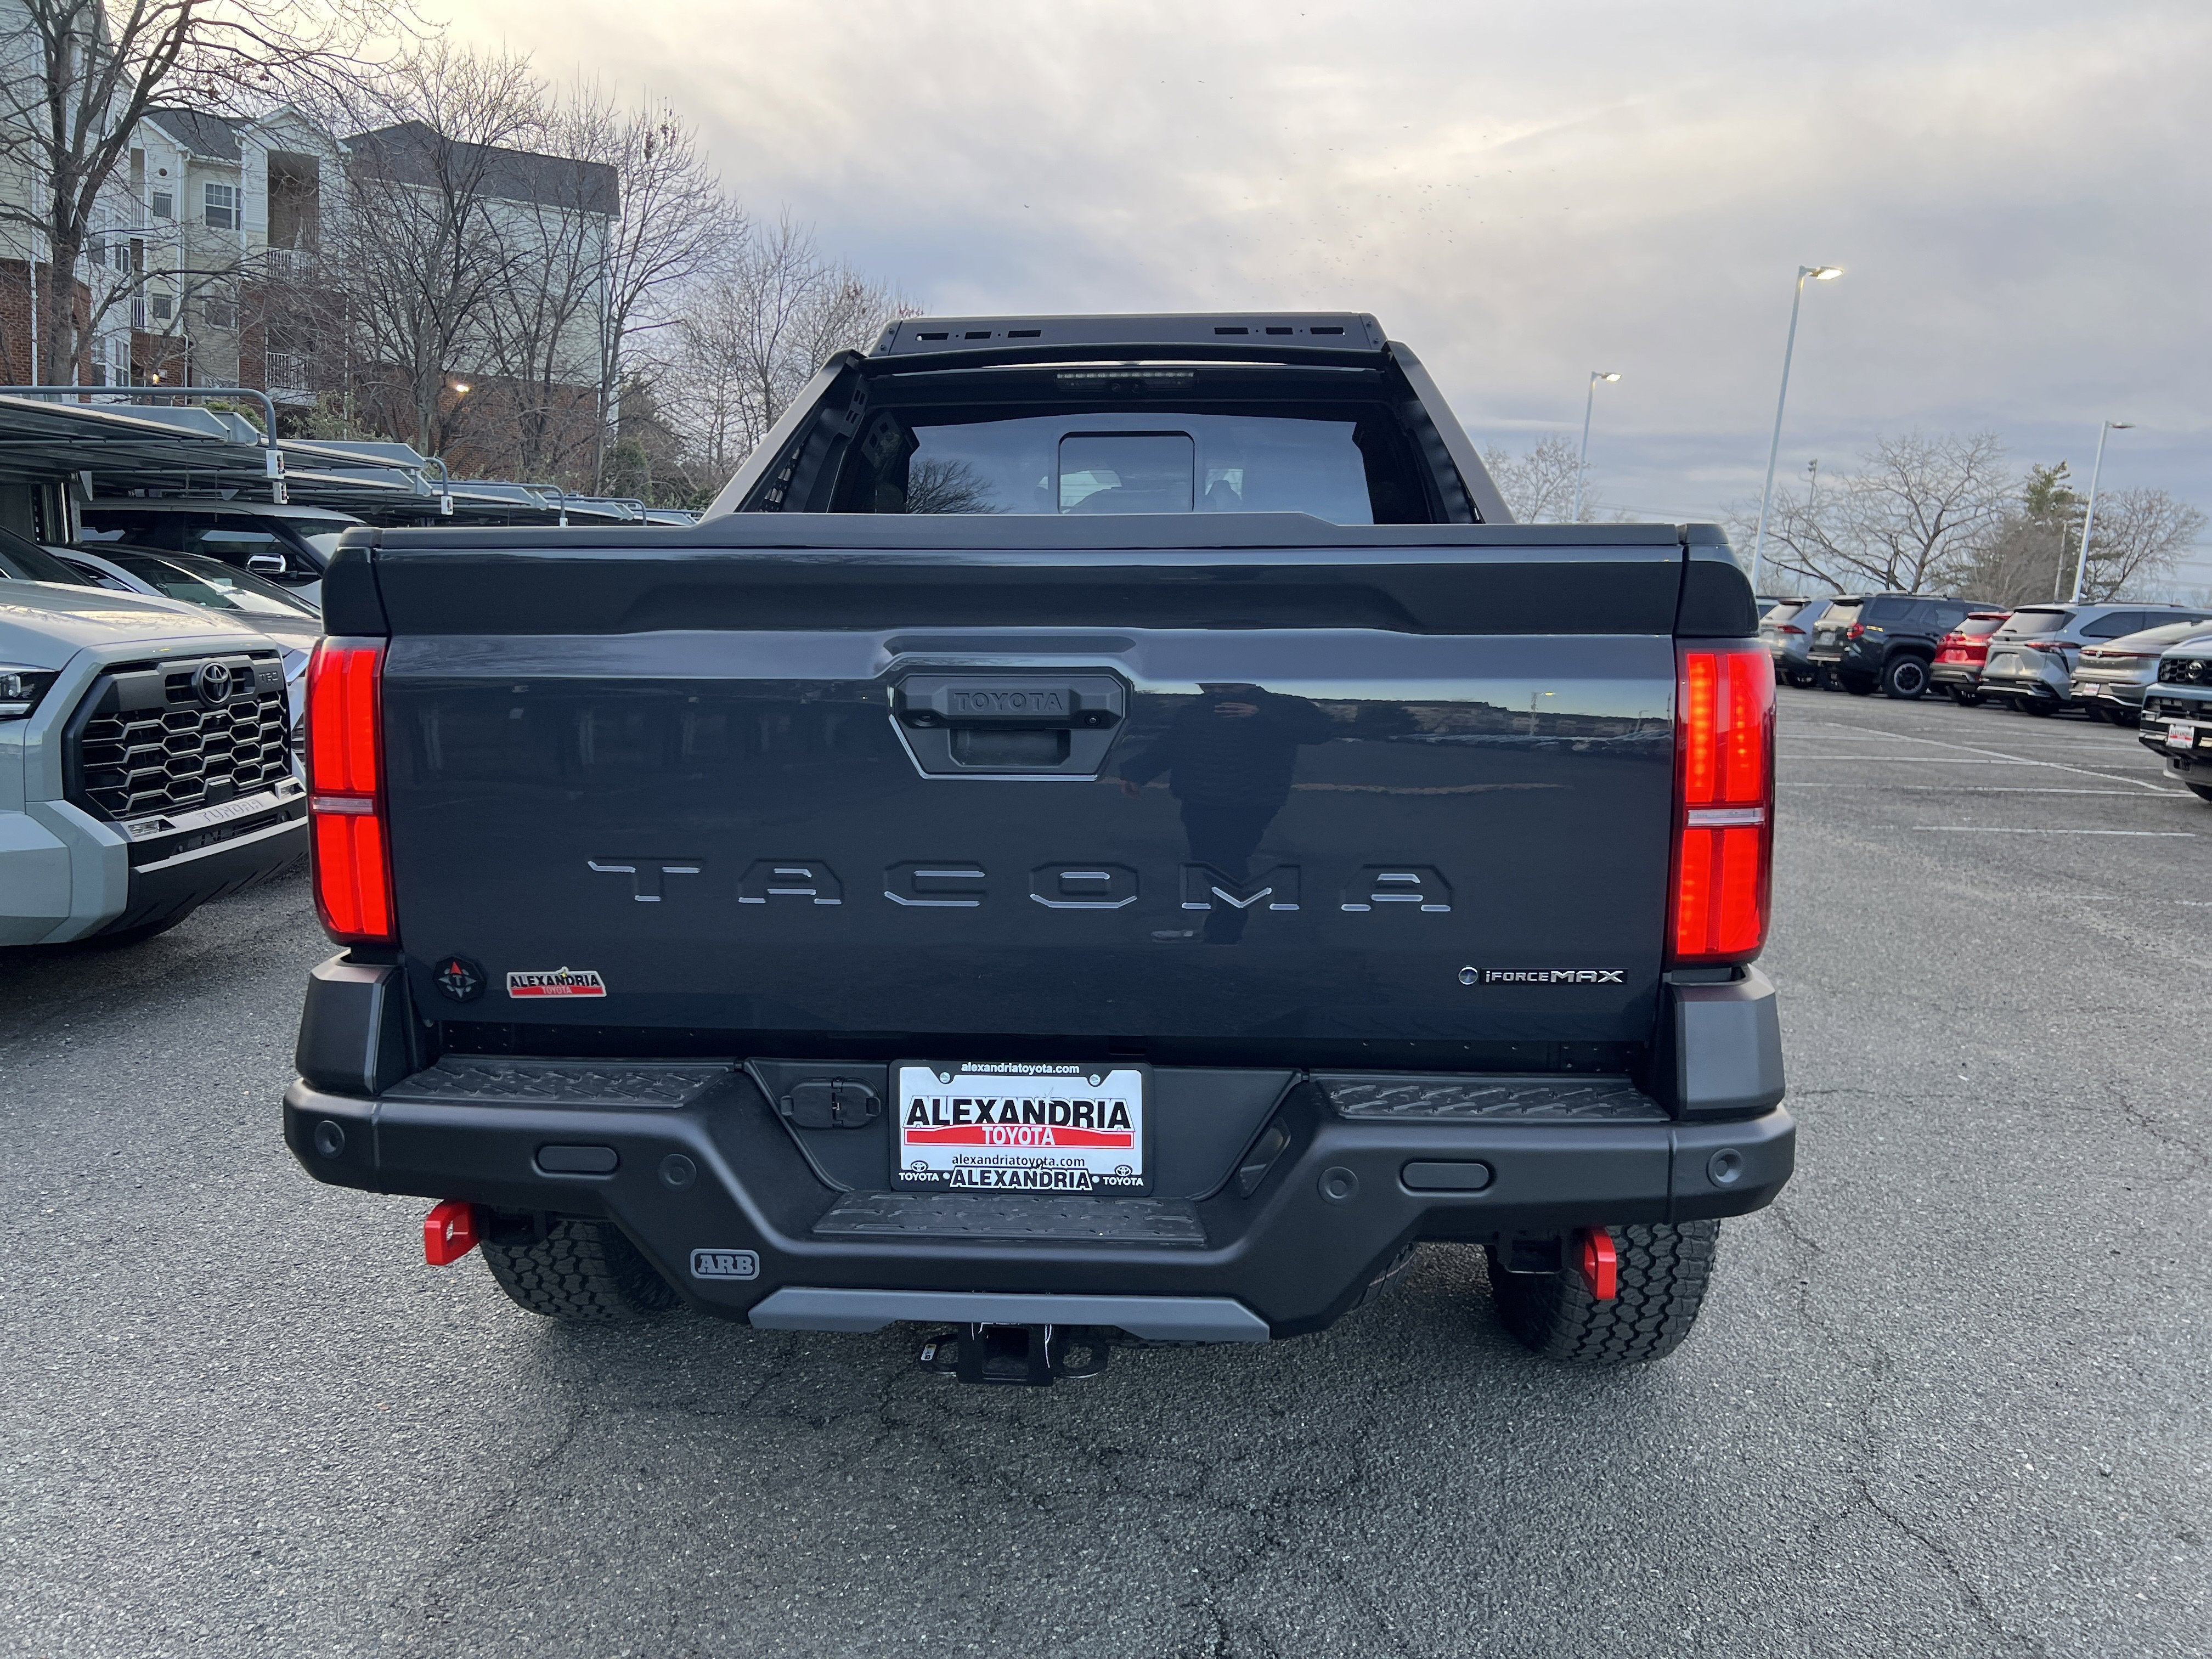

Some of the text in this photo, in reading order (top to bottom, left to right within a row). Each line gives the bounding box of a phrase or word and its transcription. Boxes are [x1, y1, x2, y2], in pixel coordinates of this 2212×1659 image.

[953, 692, 1063, 712] TOYOTA
[195, 799, 263, 822] TUNDRA
[587, 856, 1453, 912] TACOMA
[510, 974, 600, 988] ALEXANDRIA
[541, 985, 573, 995] TOYOTA
[961, 1062, 1080, 1075] alexandriatoyota.com
[906, 1098, 1132, 1130] ALEXANDRIA
[981, 1126, 1056, 1146] TOYOTA
[952, 1154, 1085, 1167] alexandriatoyota.com
[898, 1172, 940, 1182] TOYOTA
[951, 1167, 1092, 1189] ALEXANDRIA
[1102, 1176, 1144, 1187] TOYOTA
[698, 1254, 753, 1274] ARB
